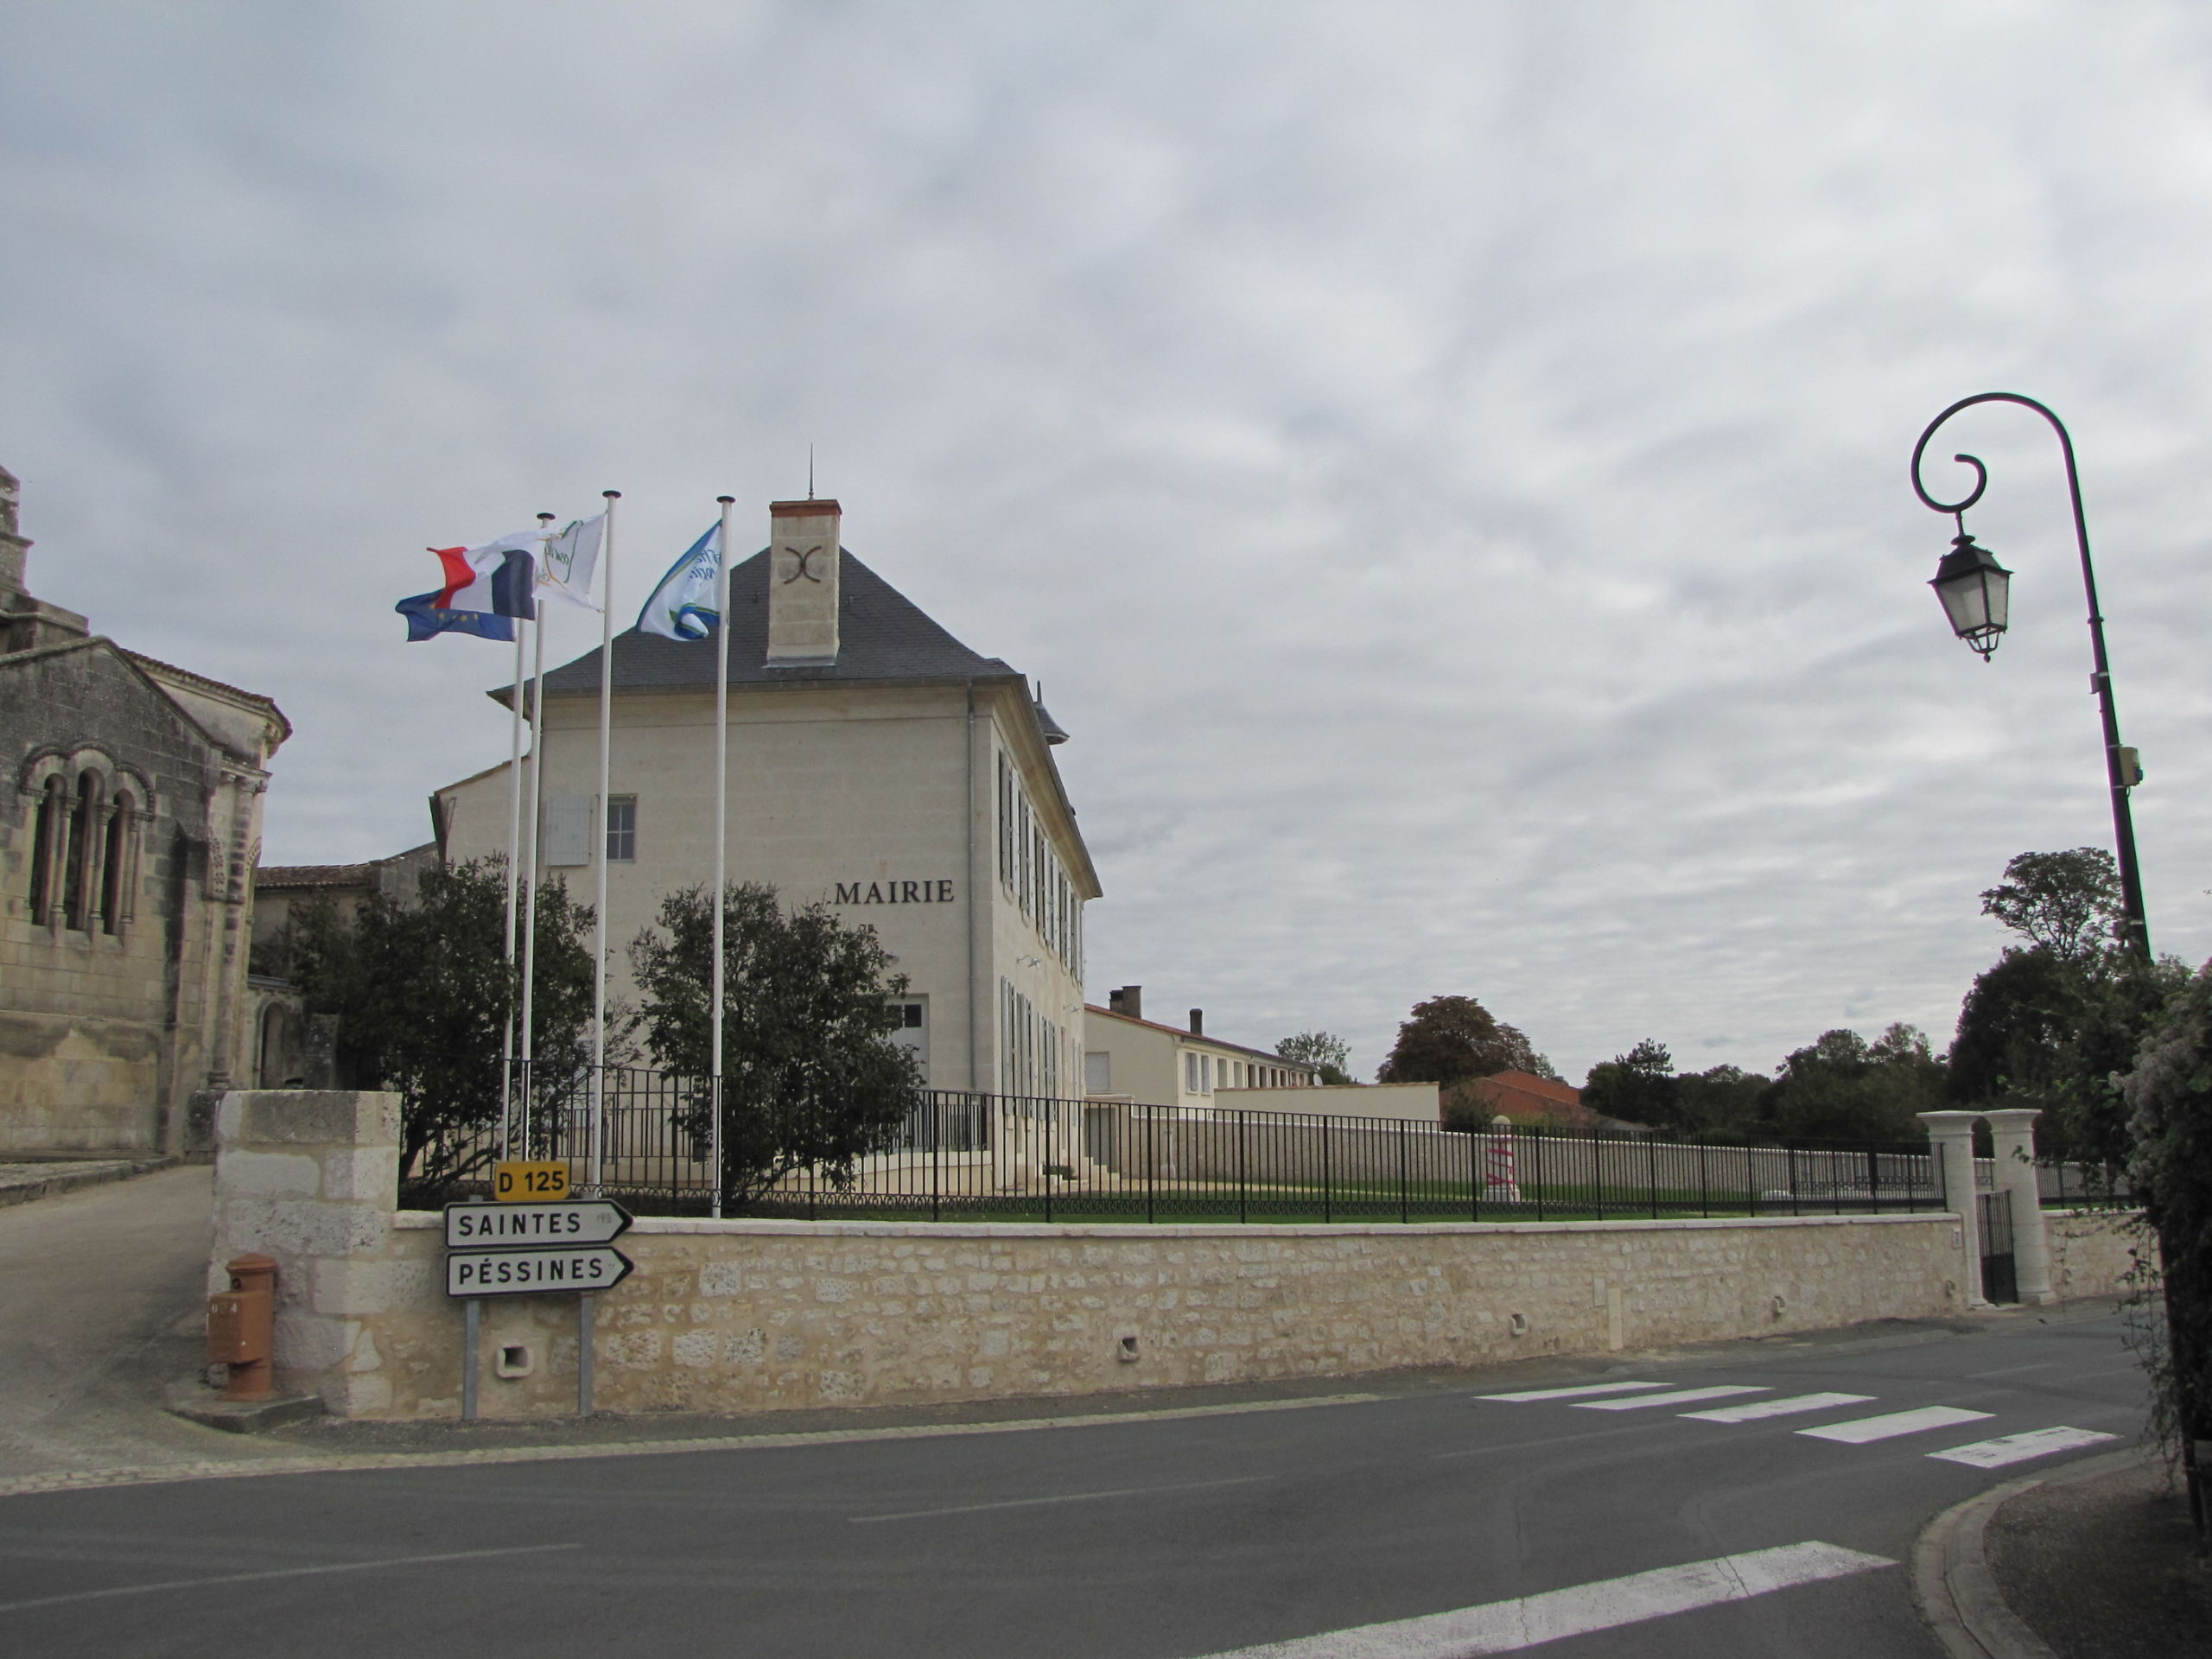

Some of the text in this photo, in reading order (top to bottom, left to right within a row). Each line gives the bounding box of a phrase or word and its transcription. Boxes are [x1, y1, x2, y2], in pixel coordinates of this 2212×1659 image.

[835, 880, 954, 905] MAIRIE
[499, 1171, 564, 1192] D 125
[458, 1212, 581, 1236] SAINTES
[459, 1257, 603, 1285] PÉSSINES
